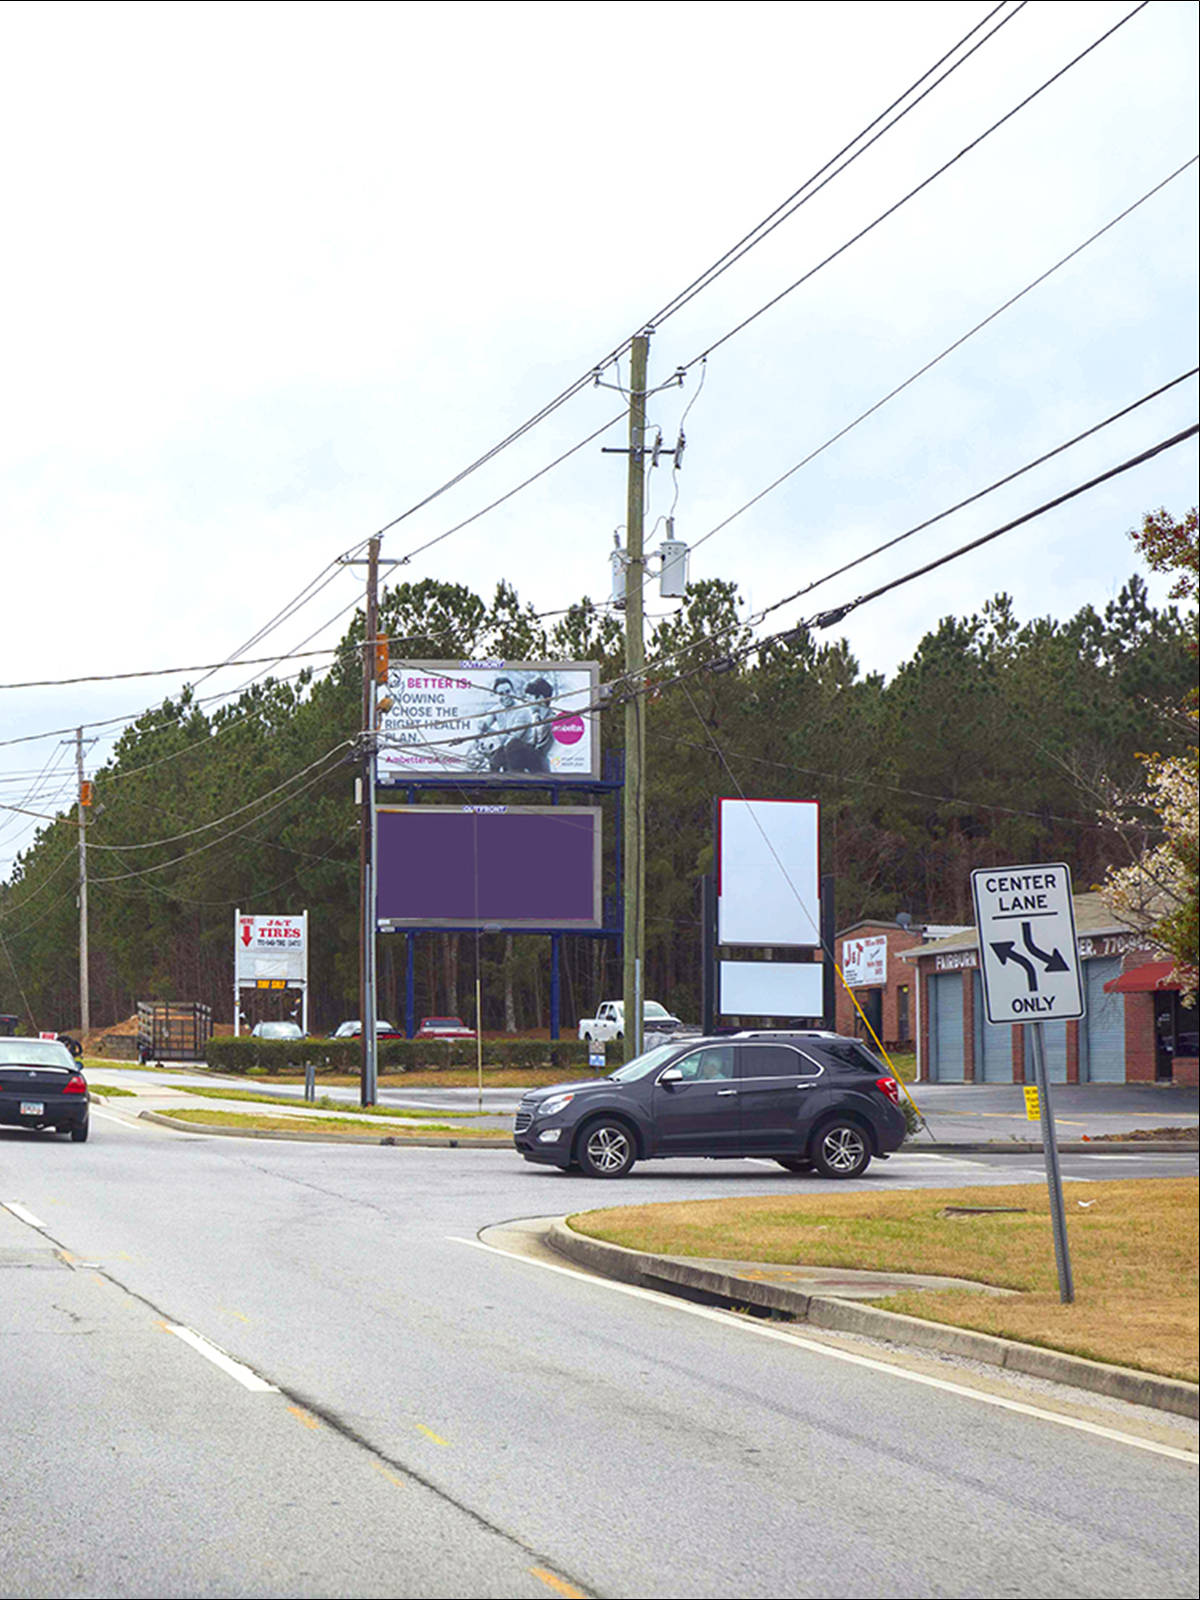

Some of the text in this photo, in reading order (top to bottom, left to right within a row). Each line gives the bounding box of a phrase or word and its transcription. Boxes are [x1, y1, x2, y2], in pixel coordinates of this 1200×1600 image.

[407, 678, 453, 689] BETTER
[385, 693, 445, 703] NOWING
[392, 707, 432, 717] CHOSE
[435, 707, 458, 717] THE
[385, 720, 471, 730] RIGHT HEALTH
[985, 874, 1056, 893] CENTER
[999, 895, 1048, 911] LANE
[258, 928, 301, 938] TIRES
[1011, 996, 1056, 1013] ONLY
